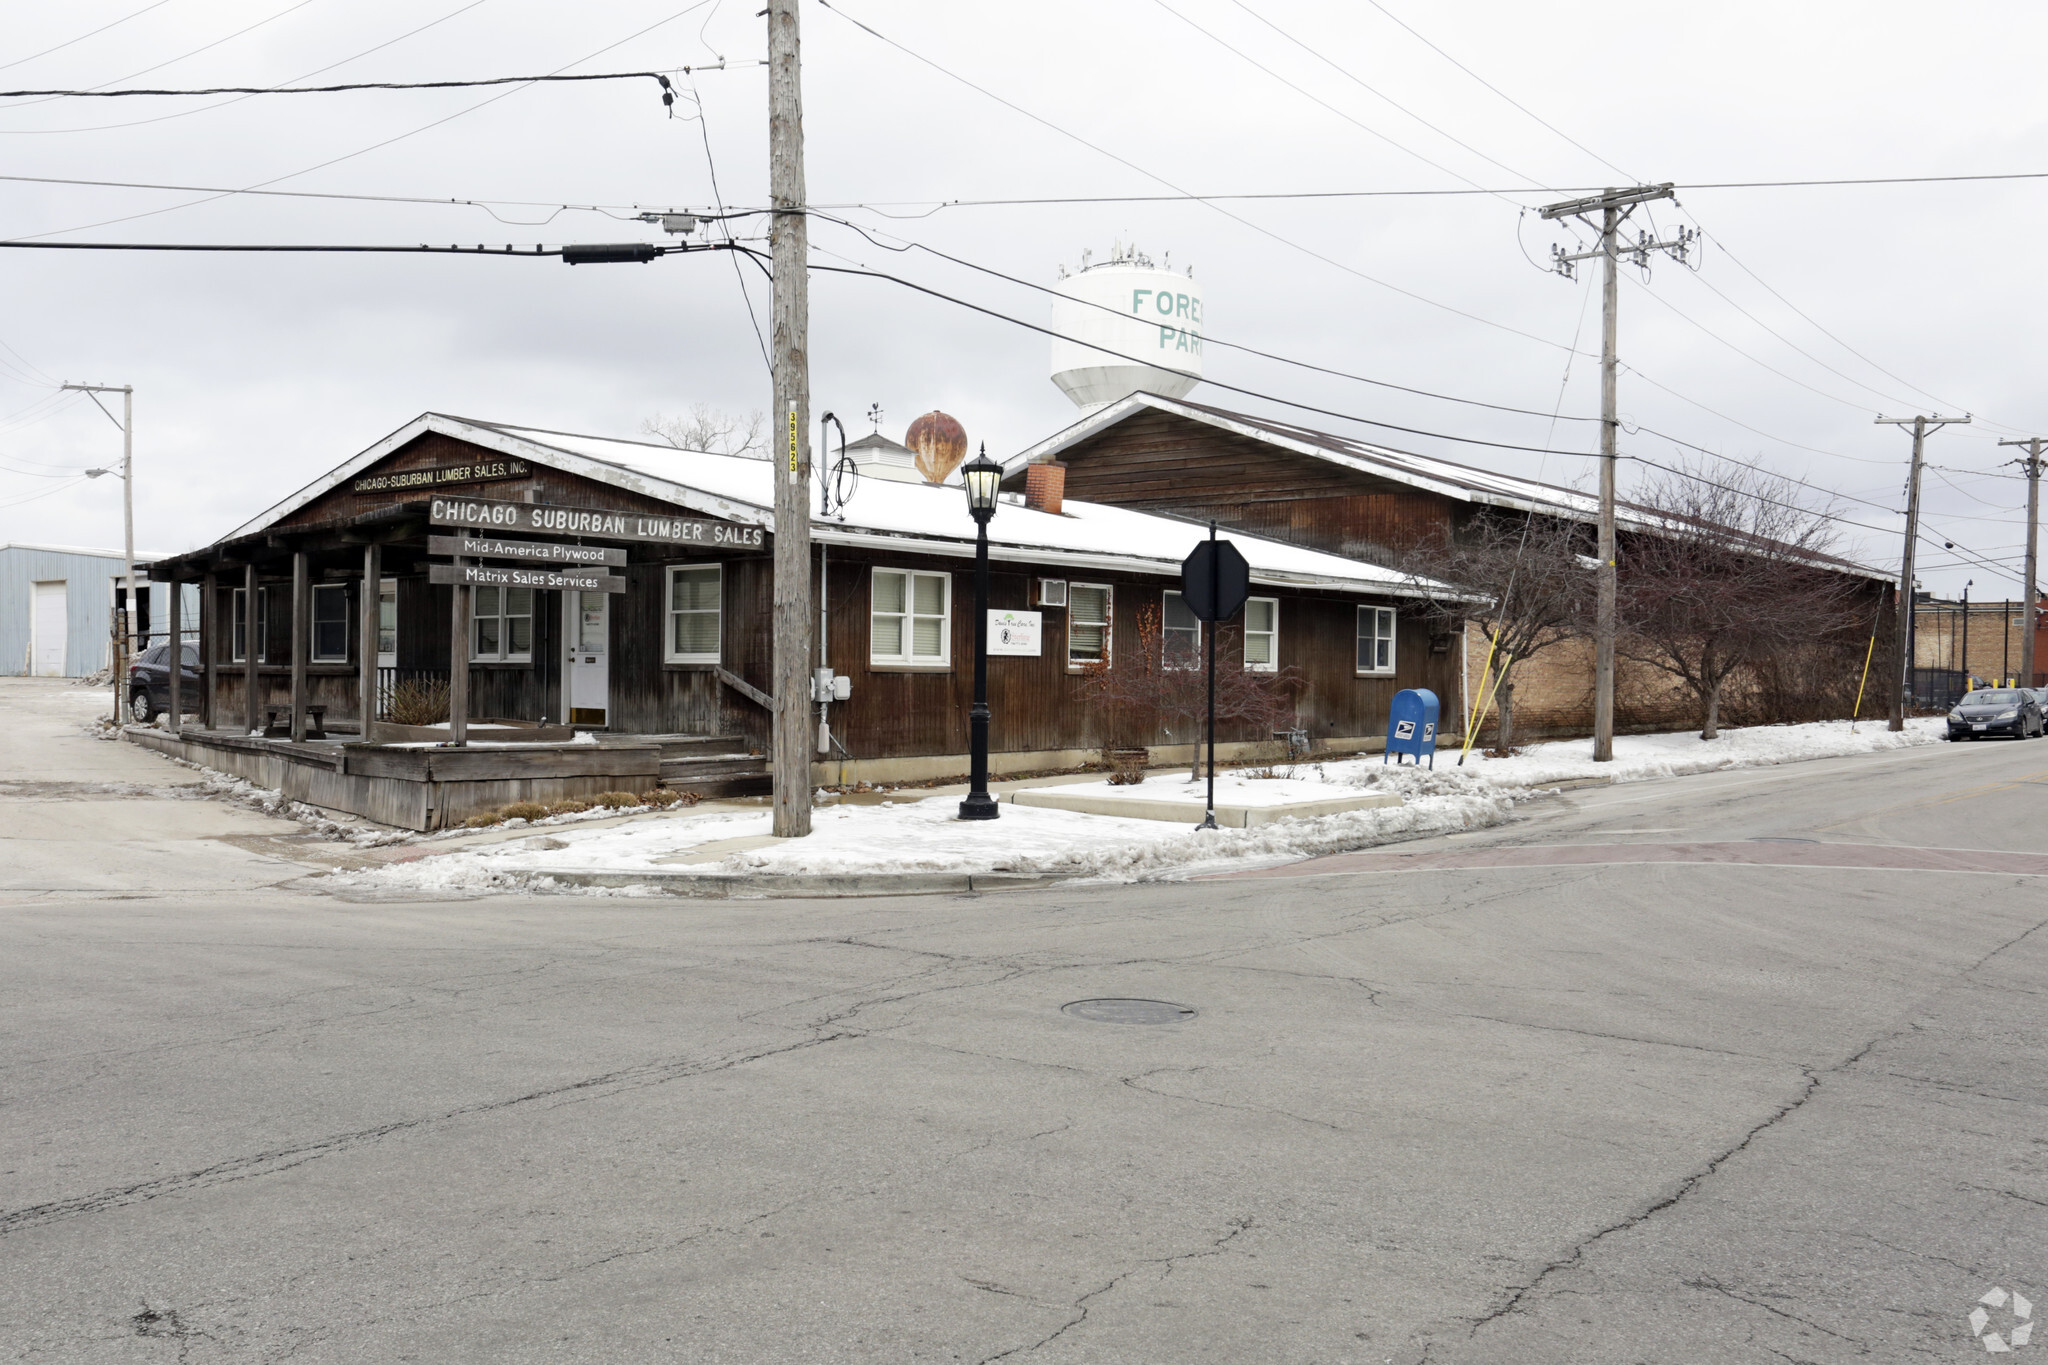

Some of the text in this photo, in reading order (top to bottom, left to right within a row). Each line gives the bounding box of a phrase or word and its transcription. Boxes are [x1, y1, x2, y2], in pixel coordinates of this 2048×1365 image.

[1133, 289, 1203, 326] FORE
[1160, 324, 1202, 357] PAR
[354, 460, 527, 491] CHICAGO-SUBURBAN LUMBER SALES, INC.
[432, 500, 762, 546] CHICAGO SUBURBAN LUMBER SALES
[464, 540, 604, 561] Mid-America Plywood
[466, 568, 598, 588] Matrix Sales Services
